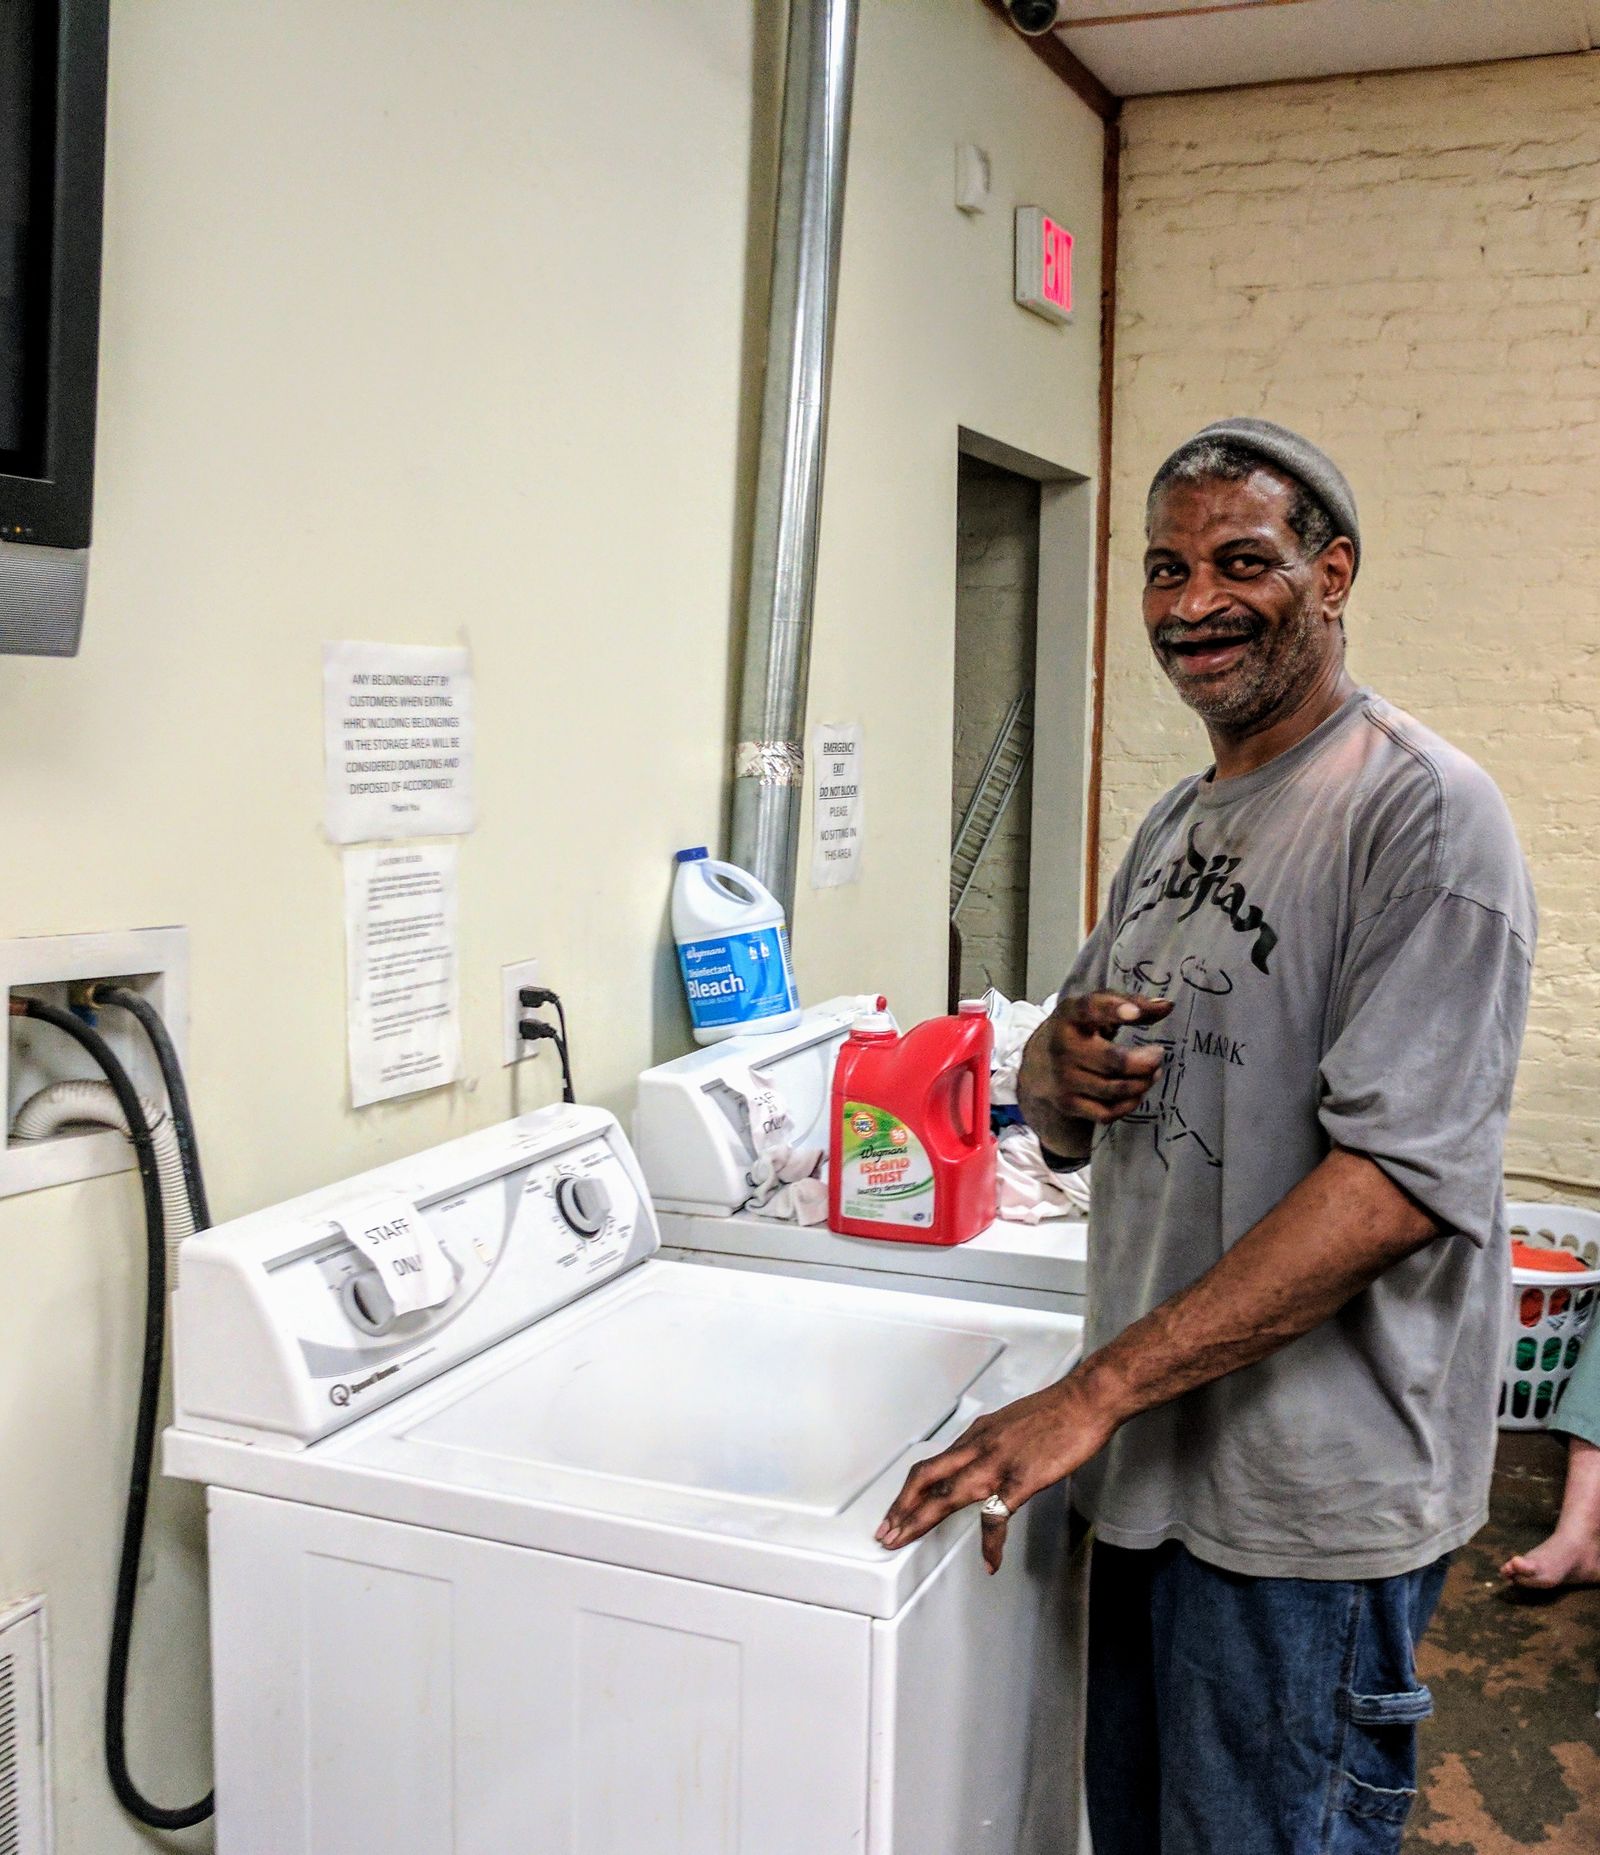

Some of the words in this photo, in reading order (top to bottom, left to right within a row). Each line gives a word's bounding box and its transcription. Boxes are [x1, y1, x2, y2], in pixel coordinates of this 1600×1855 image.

[1042, 217, 1073, 313] EXIT
[352, 674, 370, 685] ANY
[372, 674, 423, 686] BELONGINGS
[423, 675, 439, 687] LEFT
[440, 675, 449, 687] BY
[349, 696, 398, 708] CUSTOMERS
[400, 696, 423, 707] WHEN
[424, 696, 453, 707] EXITING
[343, 718, 367, 729] HHRC
[368, 718, 411, 729] INCLUDING
[412, 717, 460, 728] BELONGINGS
[344, 739, 354, 751] IN
[357, 739, 371, 751] THE
[373, 738, 410, 750] STORAGE
[411, 738, 430, 749] AREA
[432, 737, 449, 748] WILL
[451, 737, 460, 748] BE
[823, 742, 856, 753] EMERGENCY
[345, 760, 397, 773] CONSIDERED
[398, 758, 443, 771] DONATIONS
[444, 758, 459, 769] AND
[833, 763, 845, 774] EXIT
[350, 781, 390, 795] DISPOSED
[391, 781, 401, 792] OF
[819, 786, 829, 798] DO
[830, 786, 841, 797] NOT
[841, 784, 858, 797] BLOCK
[829, 806, 848, 817] PLEASE
[686, 944, 727, 963] Wegmans
[687, 974, 745, 999] Bleach
[860, 1145, 908, 1163] Wegmans
[364, 1218, 410, 1245] STAFF
